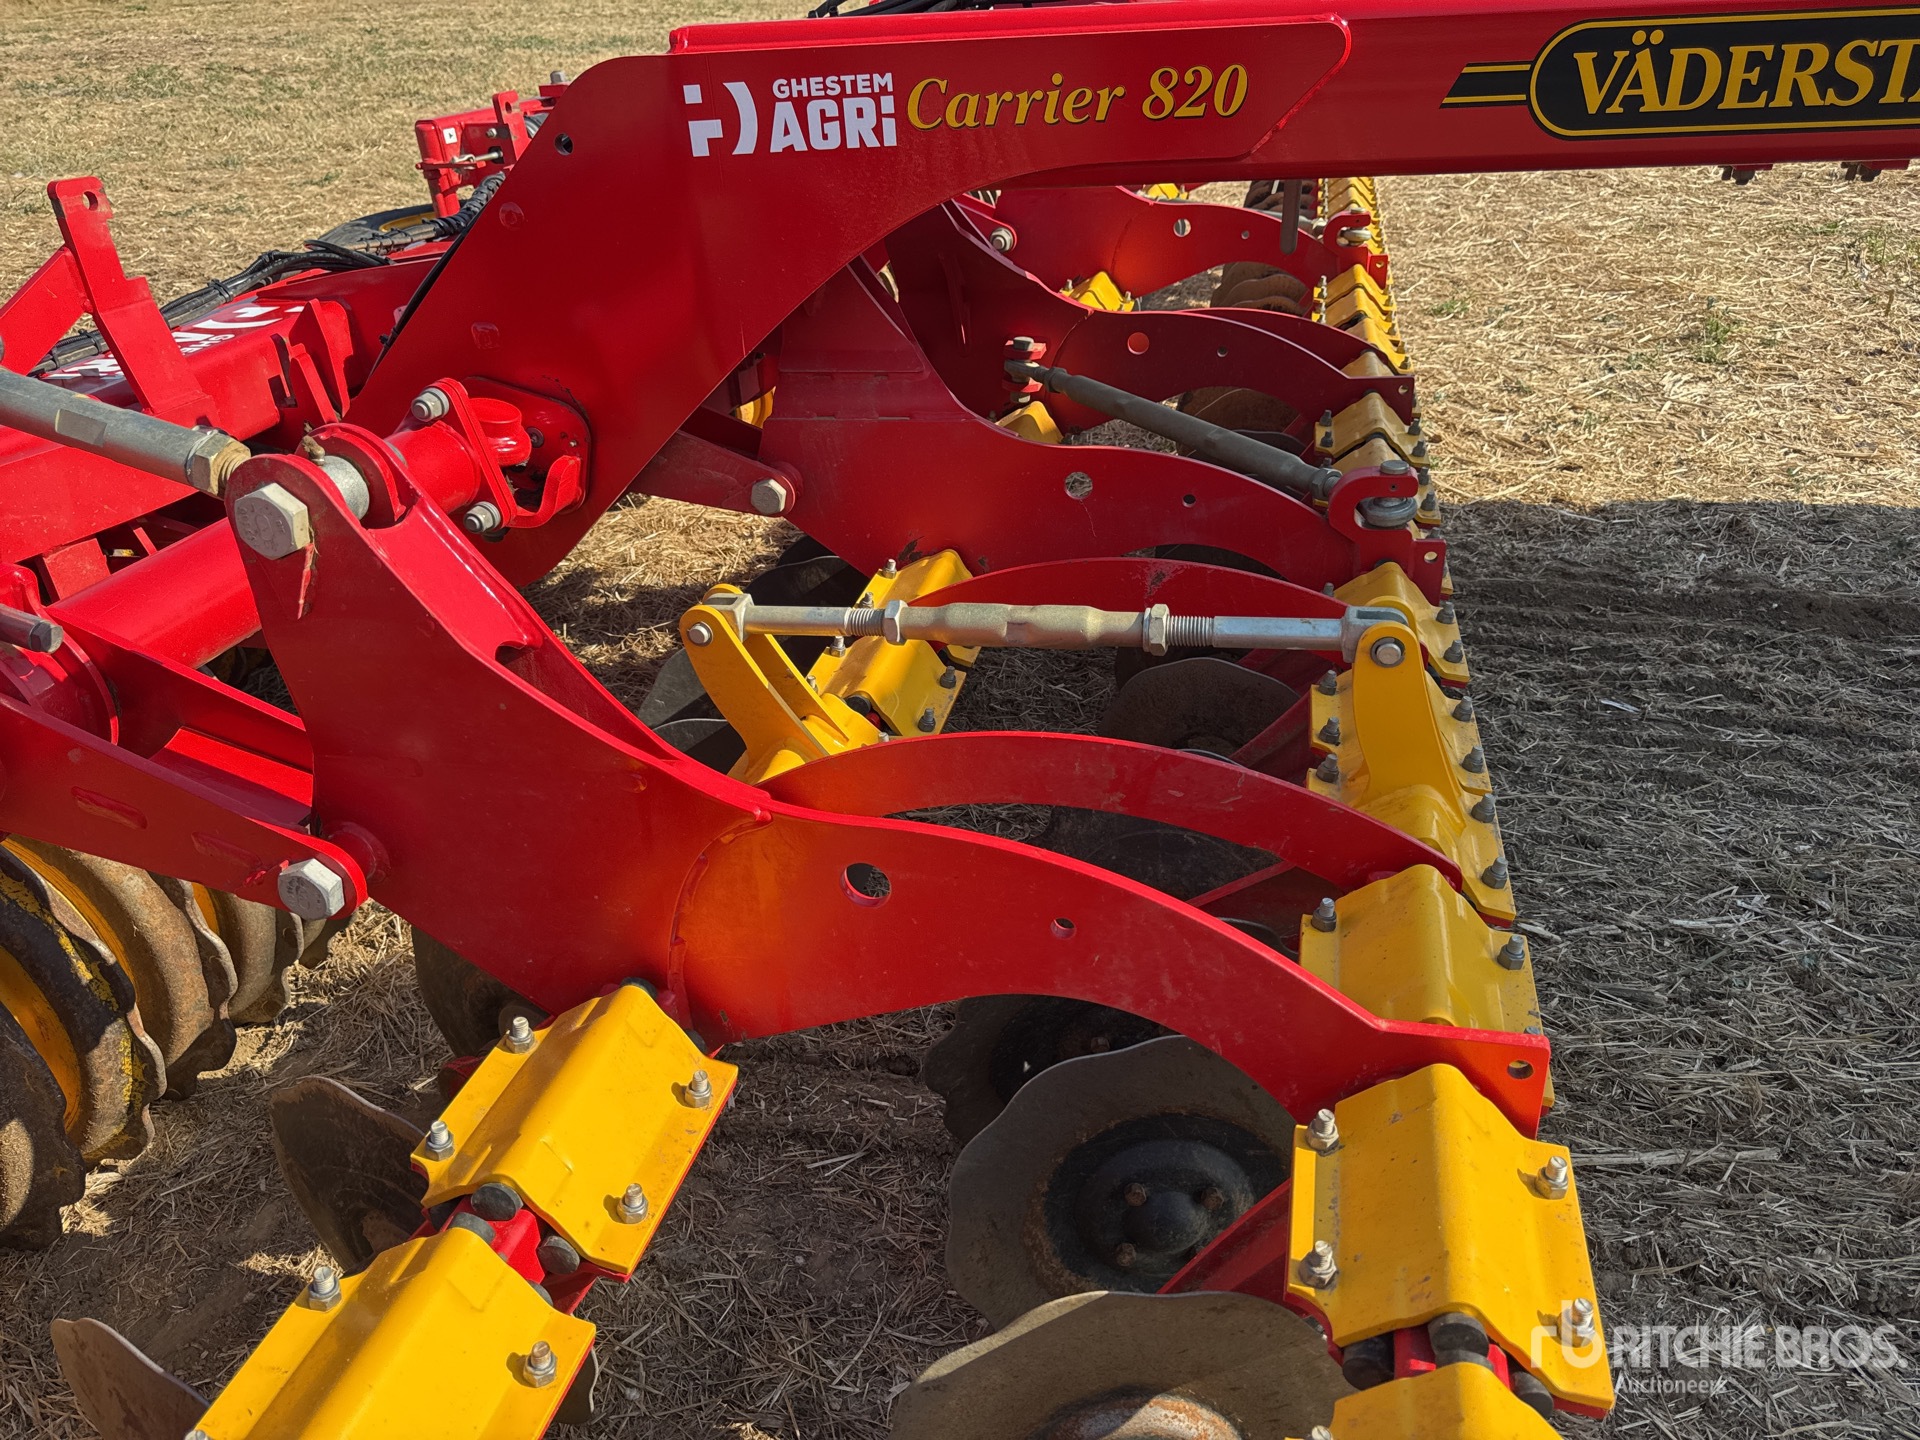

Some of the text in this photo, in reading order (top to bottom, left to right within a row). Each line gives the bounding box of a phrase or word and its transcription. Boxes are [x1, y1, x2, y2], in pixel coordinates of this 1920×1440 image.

[772, 72, 894, 99] GHESTEM
[907, 64, 1249, 131] Carrier 820
